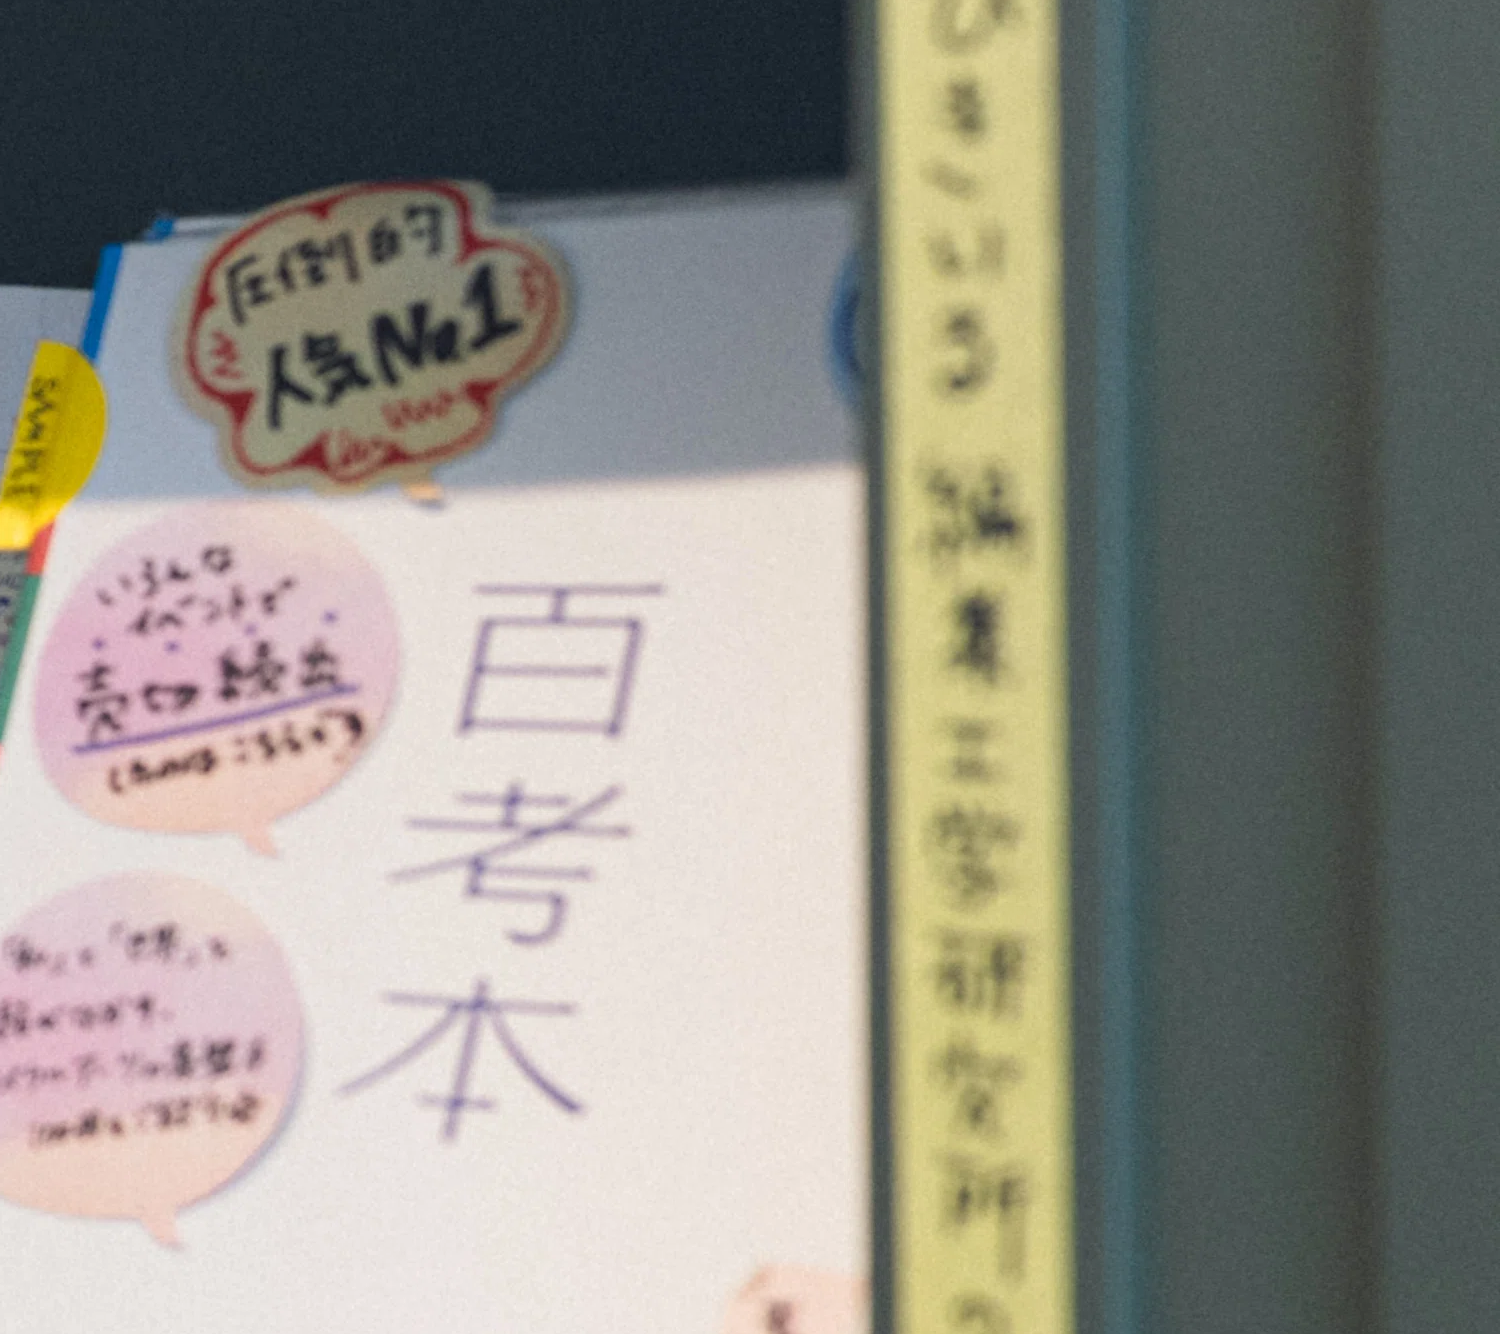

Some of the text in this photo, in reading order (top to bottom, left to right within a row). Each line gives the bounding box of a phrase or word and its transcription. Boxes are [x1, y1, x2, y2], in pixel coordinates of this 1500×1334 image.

[225, 203, 444, 327] 圧倒的
[2, 373, 58, 502] SAMPLE
[336, 582, 668, 1142] 百考本
